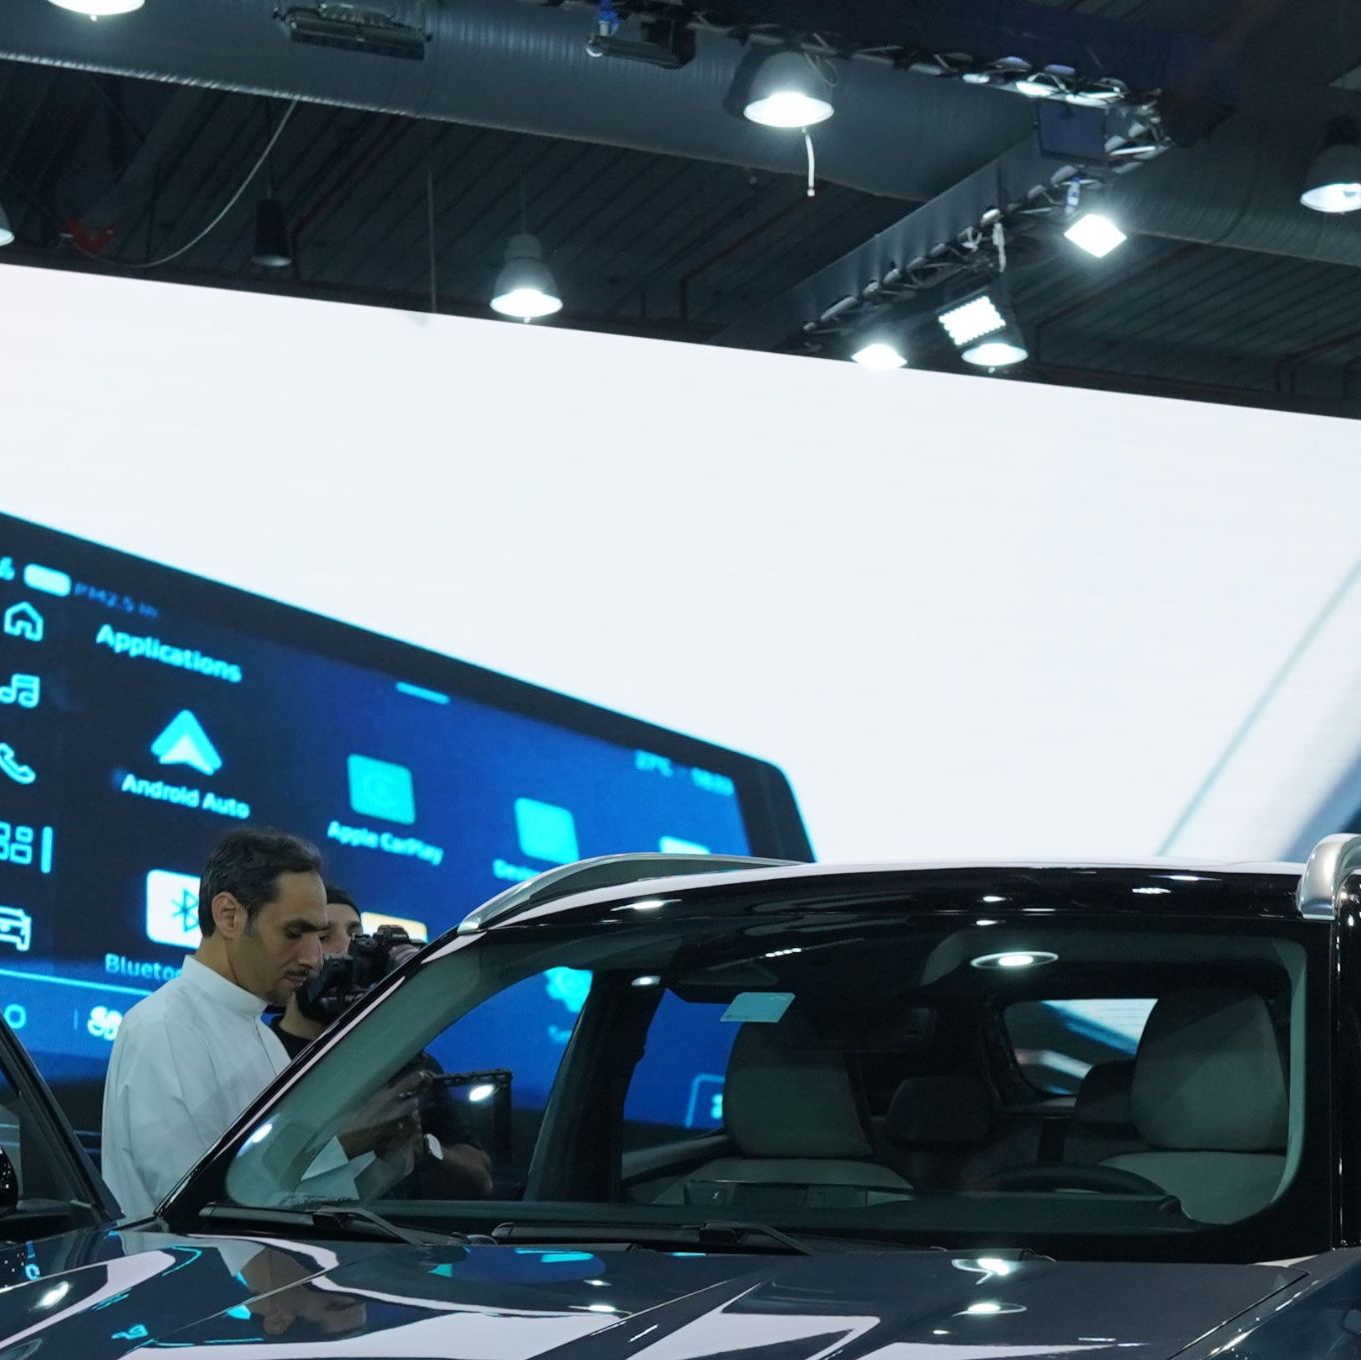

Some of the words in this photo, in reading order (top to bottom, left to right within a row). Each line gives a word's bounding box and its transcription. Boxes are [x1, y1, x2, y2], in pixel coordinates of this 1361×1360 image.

[96, 624, 243, 683] Applications
[122, 774, 199, 808] Android
[202, 792, 250, 819] Auto
[327, 820, 379, 849] Apple
[380, 832, 443, 866] CarPlay
